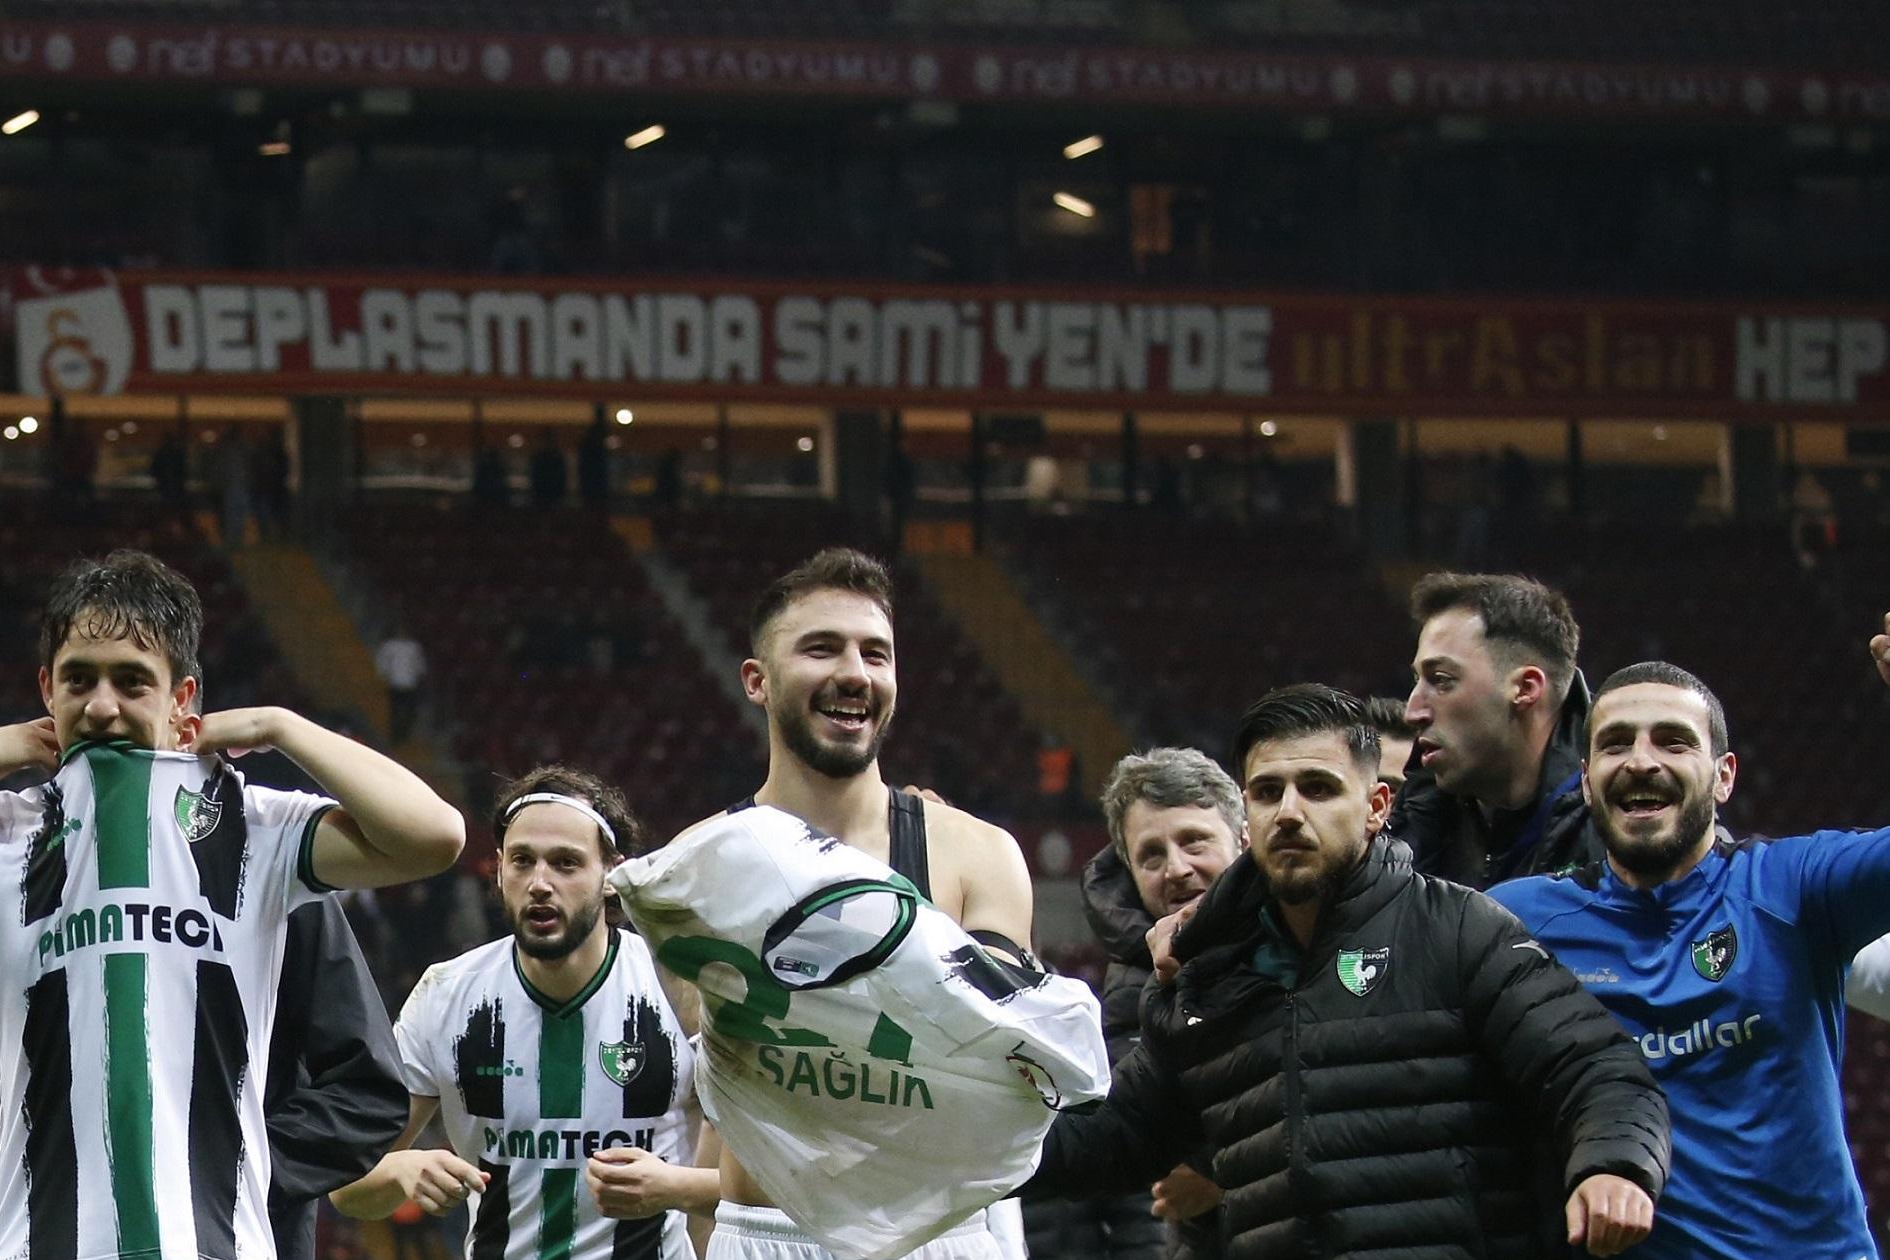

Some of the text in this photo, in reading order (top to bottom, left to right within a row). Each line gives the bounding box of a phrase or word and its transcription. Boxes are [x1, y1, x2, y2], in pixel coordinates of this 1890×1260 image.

[143, 283, 761, 384] DEPLASMANDA
[991, 299, 1273, 395] YEN'DE
[1290, 311, 1717, 397] ultrAslan
[1733, 315, 1890, 404] HEP
[1632, 1013, 1761, 1060] dallar
